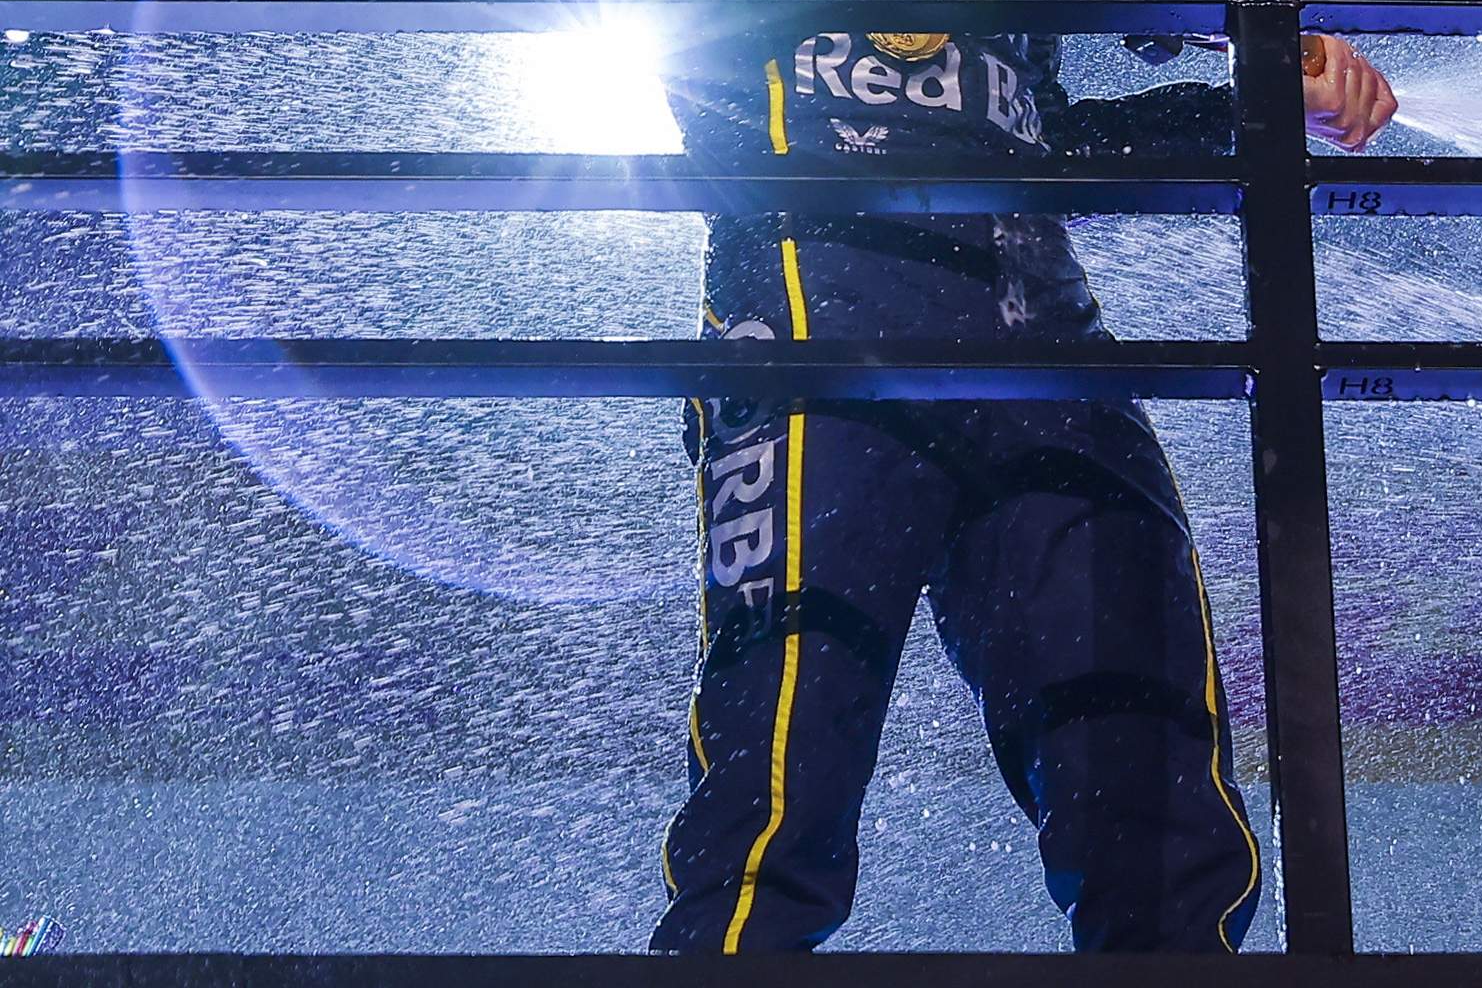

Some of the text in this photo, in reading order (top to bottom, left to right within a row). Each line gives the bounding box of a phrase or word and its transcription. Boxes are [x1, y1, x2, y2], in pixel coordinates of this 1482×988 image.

[794, 32, 963, 112] Red
[1327, 191, 1382, 211] H8
[1339, 376, 1394, 396] H8
